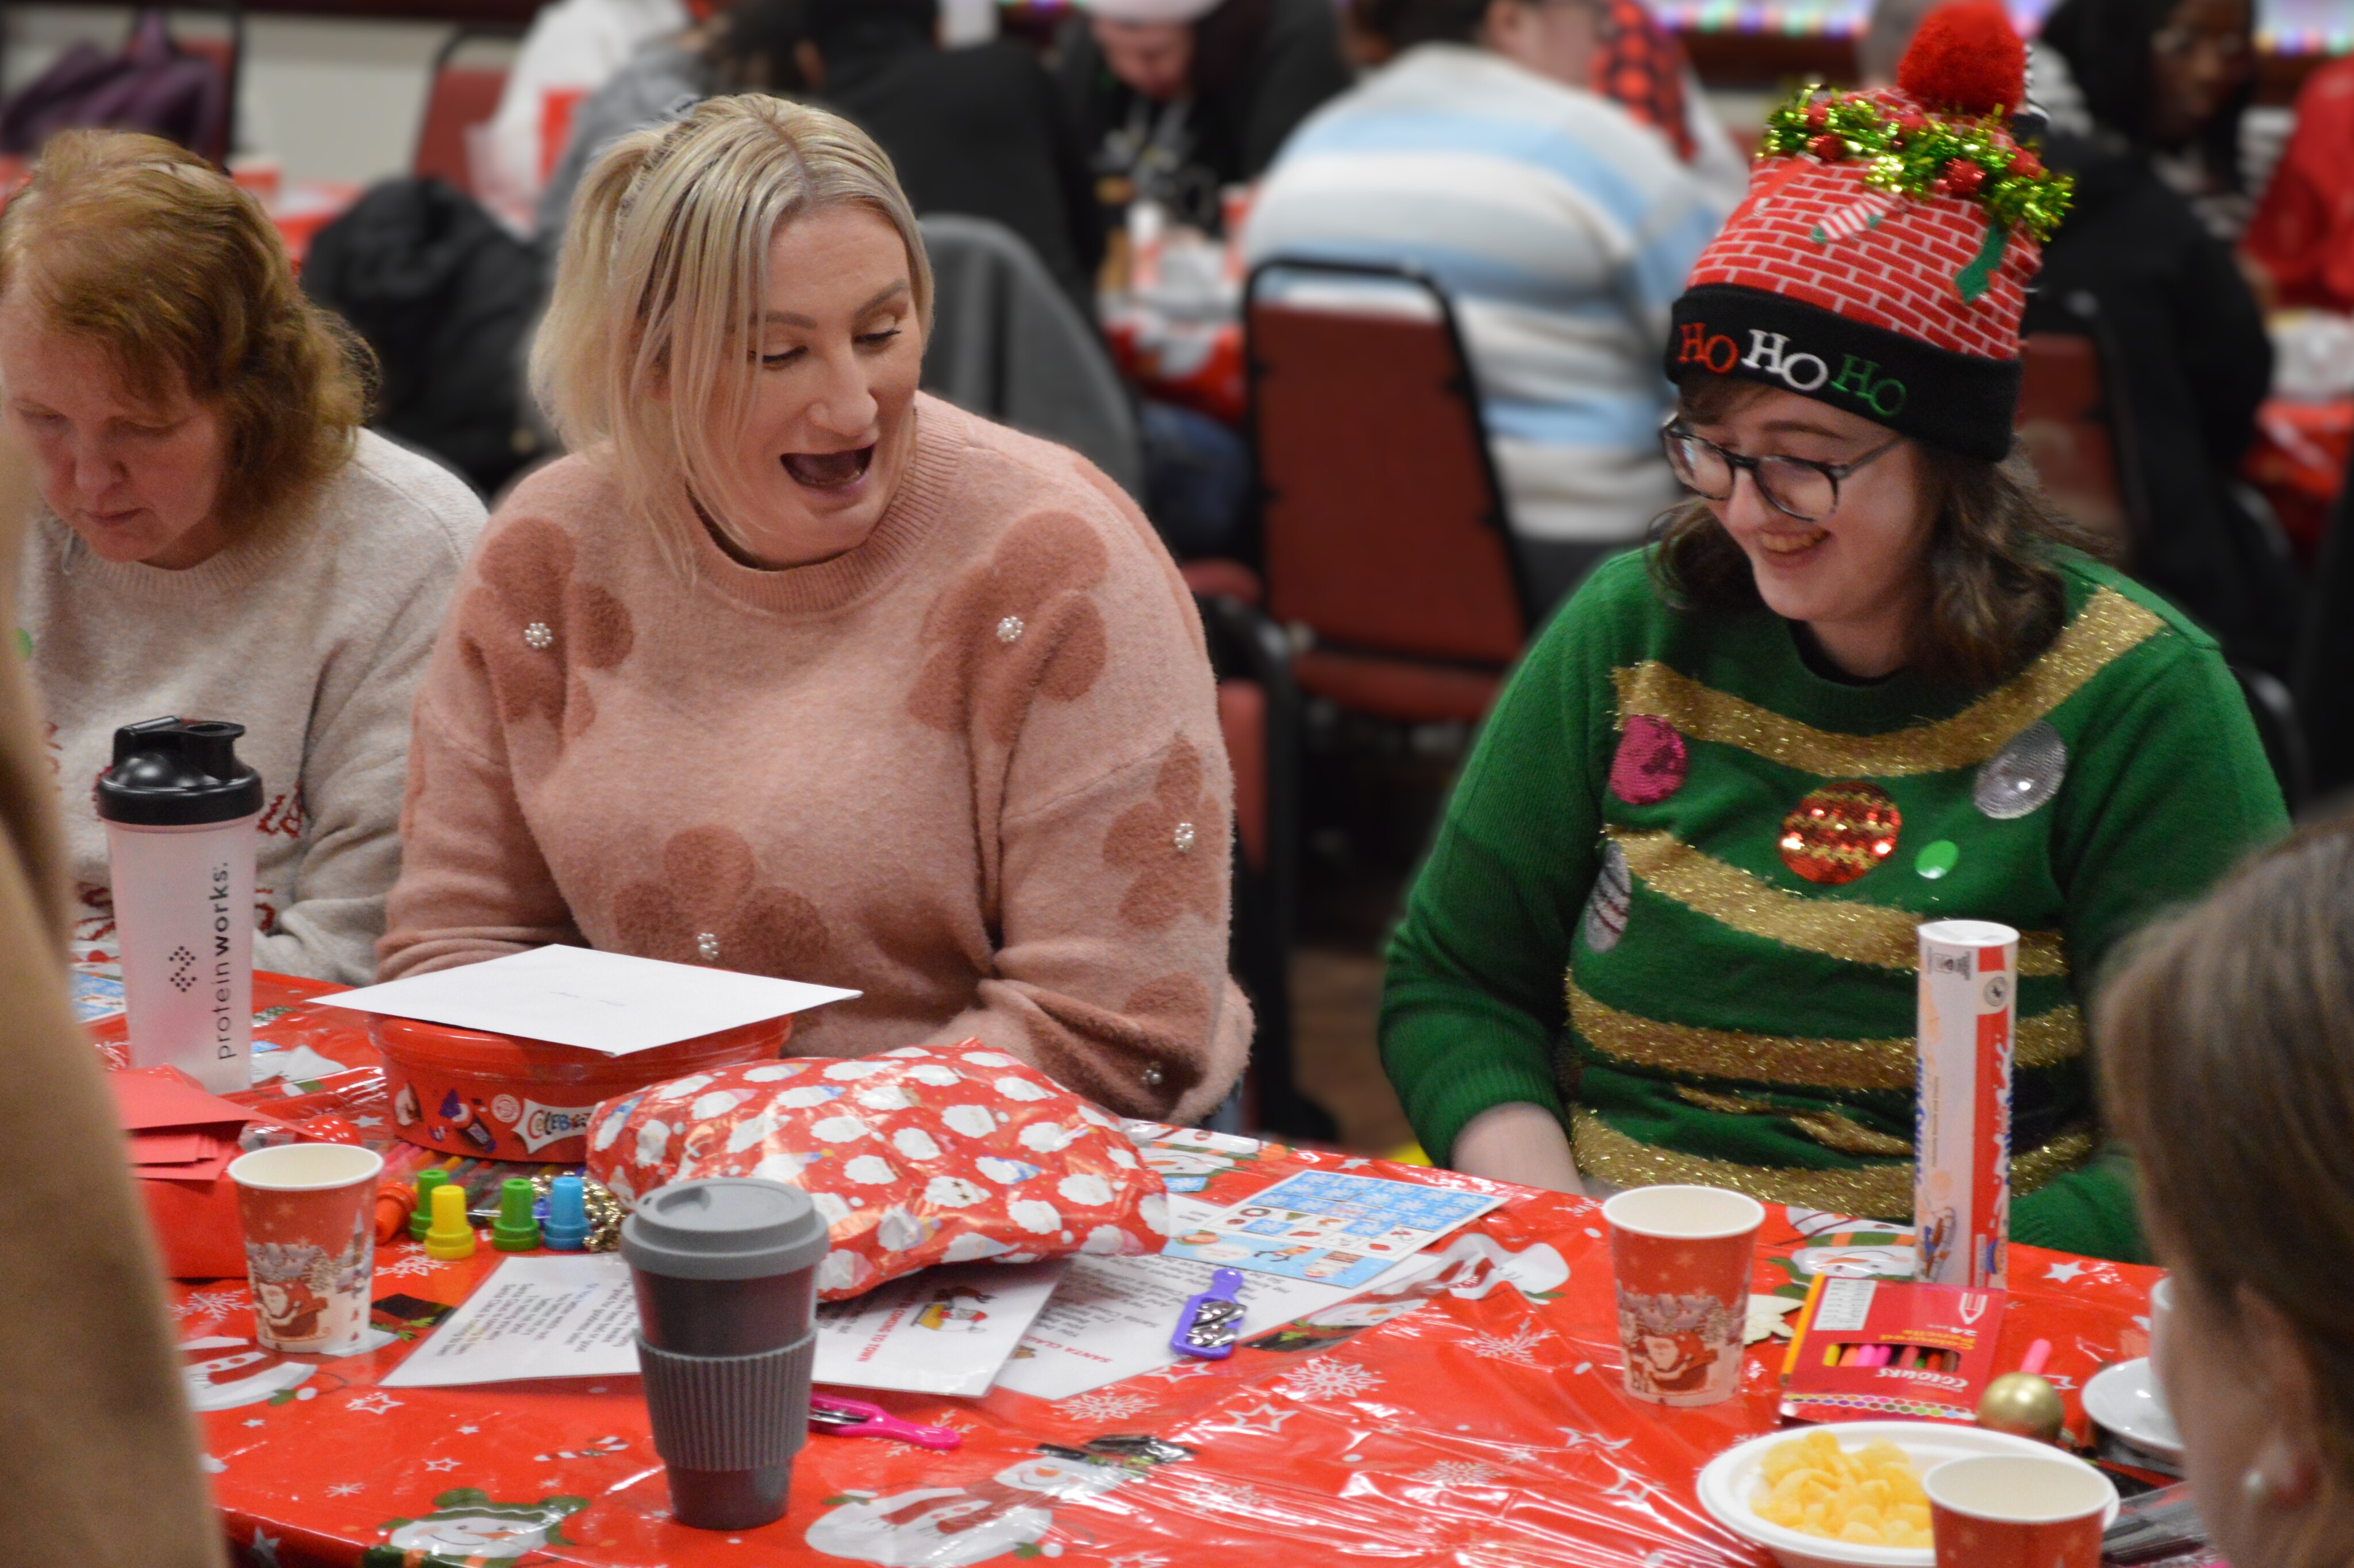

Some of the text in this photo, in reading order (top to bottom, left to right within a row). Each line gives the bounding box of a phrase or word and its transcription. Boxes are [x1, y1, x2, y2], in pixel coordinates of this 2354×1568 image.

[1677, 322, 1907, 417] HO HO HO
[211, 961, 237, 1060] protein
[871, 1334, 888, 1342] TO
[856, 1344, 881, 1362] TOWN
[1064, 1347, 1113, 1363] SANTA
